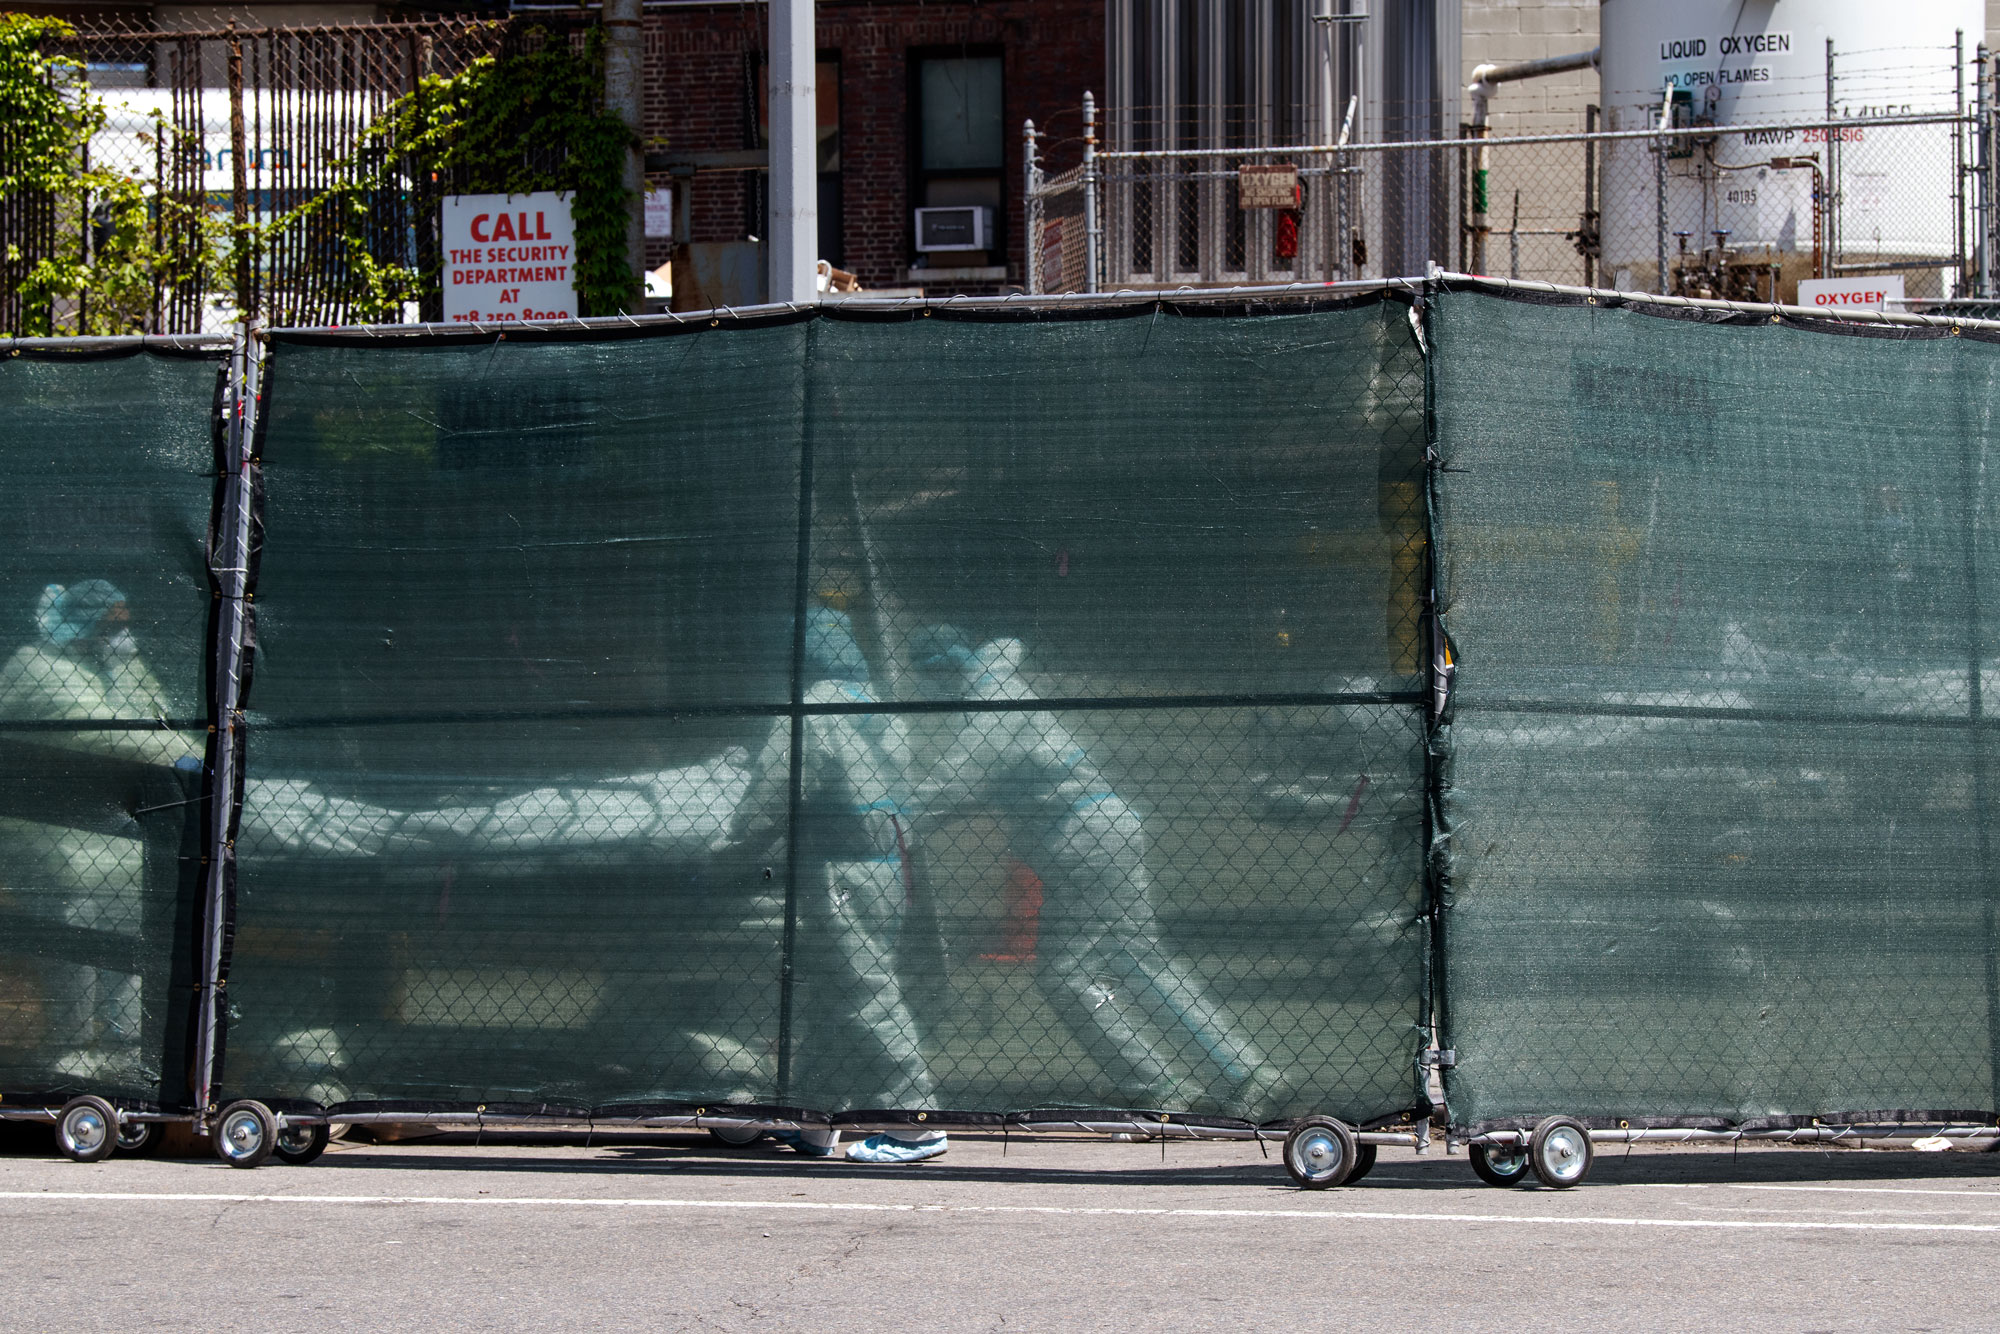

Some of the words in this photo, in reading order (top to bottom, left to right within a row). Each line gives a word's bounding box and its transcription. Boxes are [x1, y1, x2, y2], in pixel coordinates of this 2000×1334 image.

[1661, 39, 1706, 60] LIQUID
[1720, 34, 1790, 55] OXYGEN
[1665, 74, 1679, 88] NO
[1684, 71, 1714, 86] OPEN
[1719, 68, 1769, 84] FLAMES
[1744, 131, 1795, 145] MAWP
[1803, 129, 1829, 142] 250
[1241, 172, 1296, 187] OXYGEN
[470, 211, 552, 243] CALL
[450, 248, 482, 264] THE
[488, 245, 569, 263] SECURITY
[453, 266, 567, 285] DEPARTMENT
[499, 289, 520, 303] AT
[1815, 290, 1887, 306] OXYGEN
